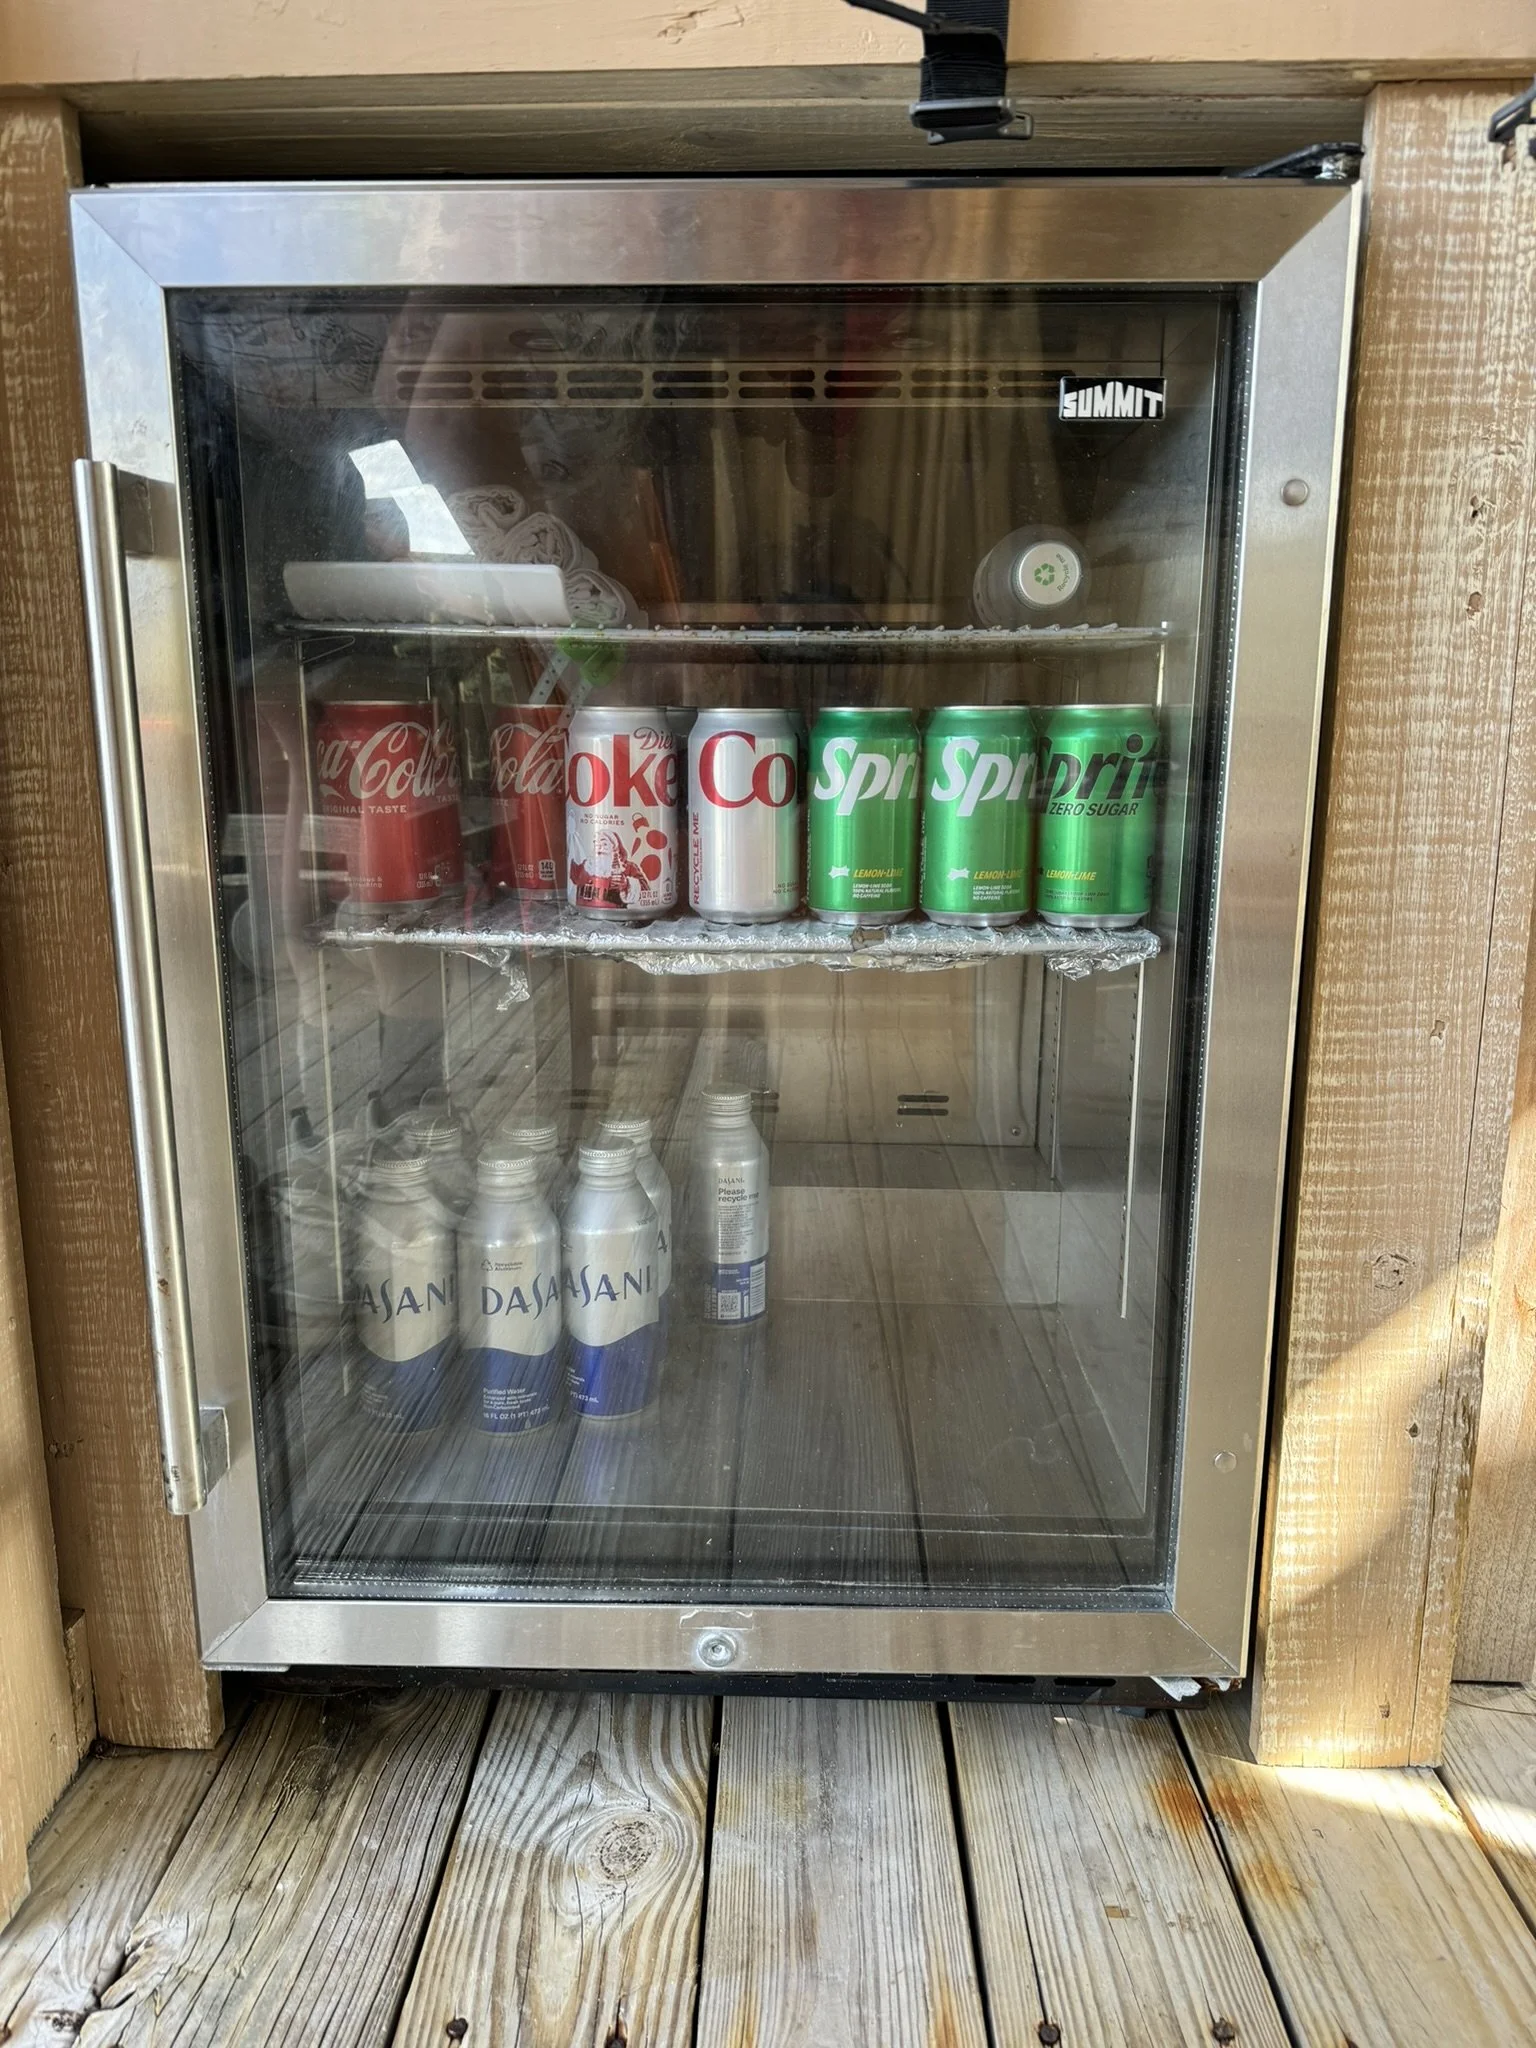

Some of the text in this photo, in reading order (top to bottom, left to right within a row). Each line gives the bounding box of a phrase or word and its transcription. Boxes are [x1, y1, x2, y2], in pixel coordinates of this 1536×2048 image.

[1063, 381, 1163, 417] SUMMIT
[699, 730, 796, 808] Co
[369, 805, 408, 813] TASTE
[1049, 802, 1139, 816] ZERO SUGAR
[692, 811, 700, 904] RECYCLE ME
[1046, 869, 1097, 881] LEMON-LIME
[718, 1188, 746, 1196] Please
[718, 1194, 748, 1203] recycle
